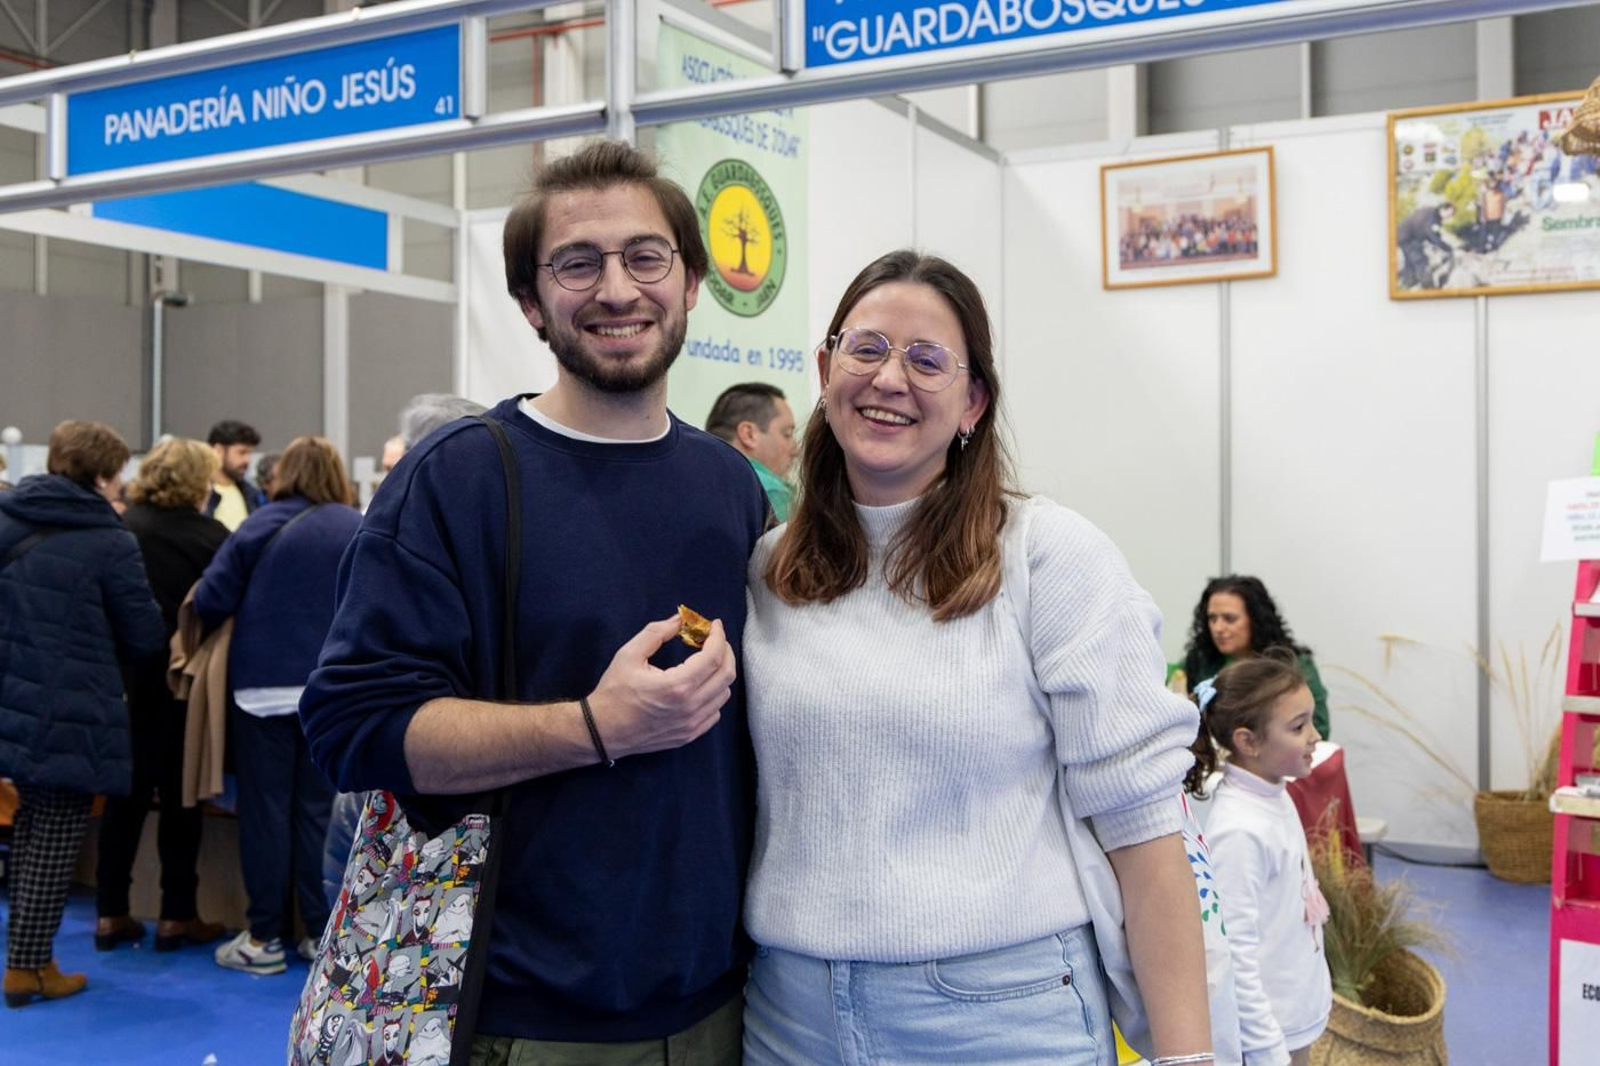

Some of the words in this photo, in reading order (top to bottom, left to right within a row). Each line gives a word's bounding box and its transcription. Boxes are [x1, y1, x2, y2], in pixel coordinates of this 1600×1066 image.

[104, 85, 246, 145] PANADERÍA
[252, 76, 327, 122] NIÑO
[333, 57, 417, 110] JESÚS
[434, 95, 454, 115] 41
[686, 336, 740, 363] undada
[747, 349, 763, 366] en
[768, 346, 804, 373] 1995
